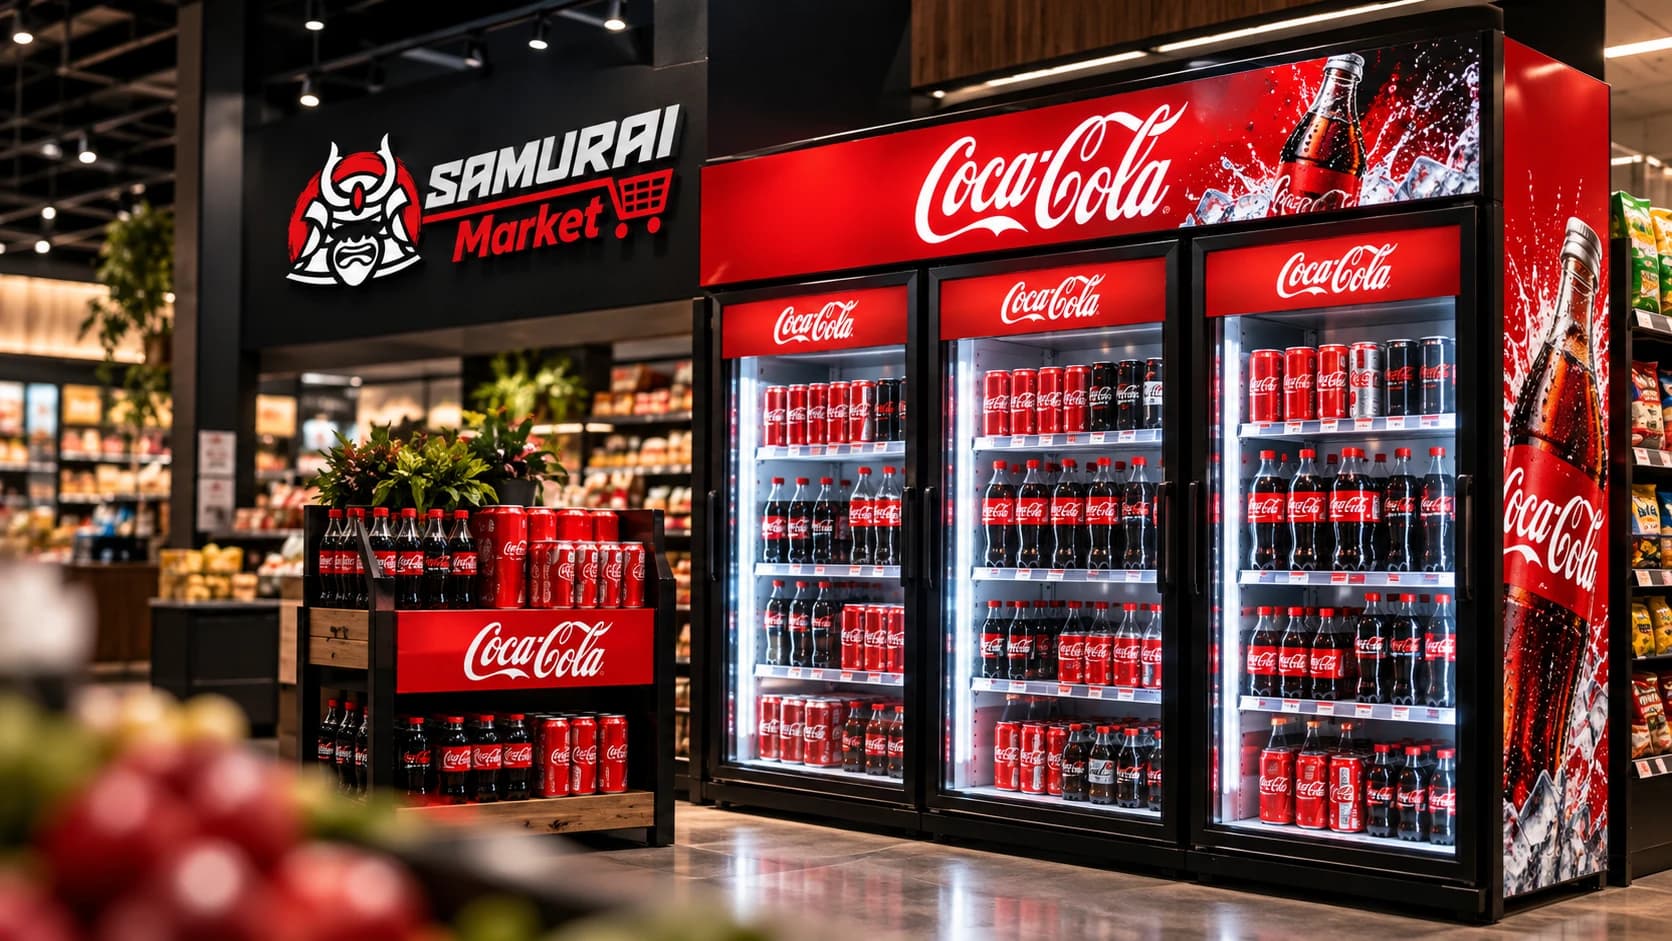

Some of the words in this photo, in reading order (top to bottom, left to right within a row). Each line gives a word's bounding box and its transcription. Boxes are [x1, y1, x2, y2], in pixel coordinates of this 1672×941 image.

[425, 104, 681, 209] SAMURAI
[915, 101, 1188, 244] Coca-Cola
[453, 195, 603, 262] Market
[1001, 273, 1106, 324] Coca-Cola
[1276, 243, 1398, 298] Coca-Cola
[773, 300, 859, 345] Coca-Cola
[464, 621, 613, 680] Coca-Cola
